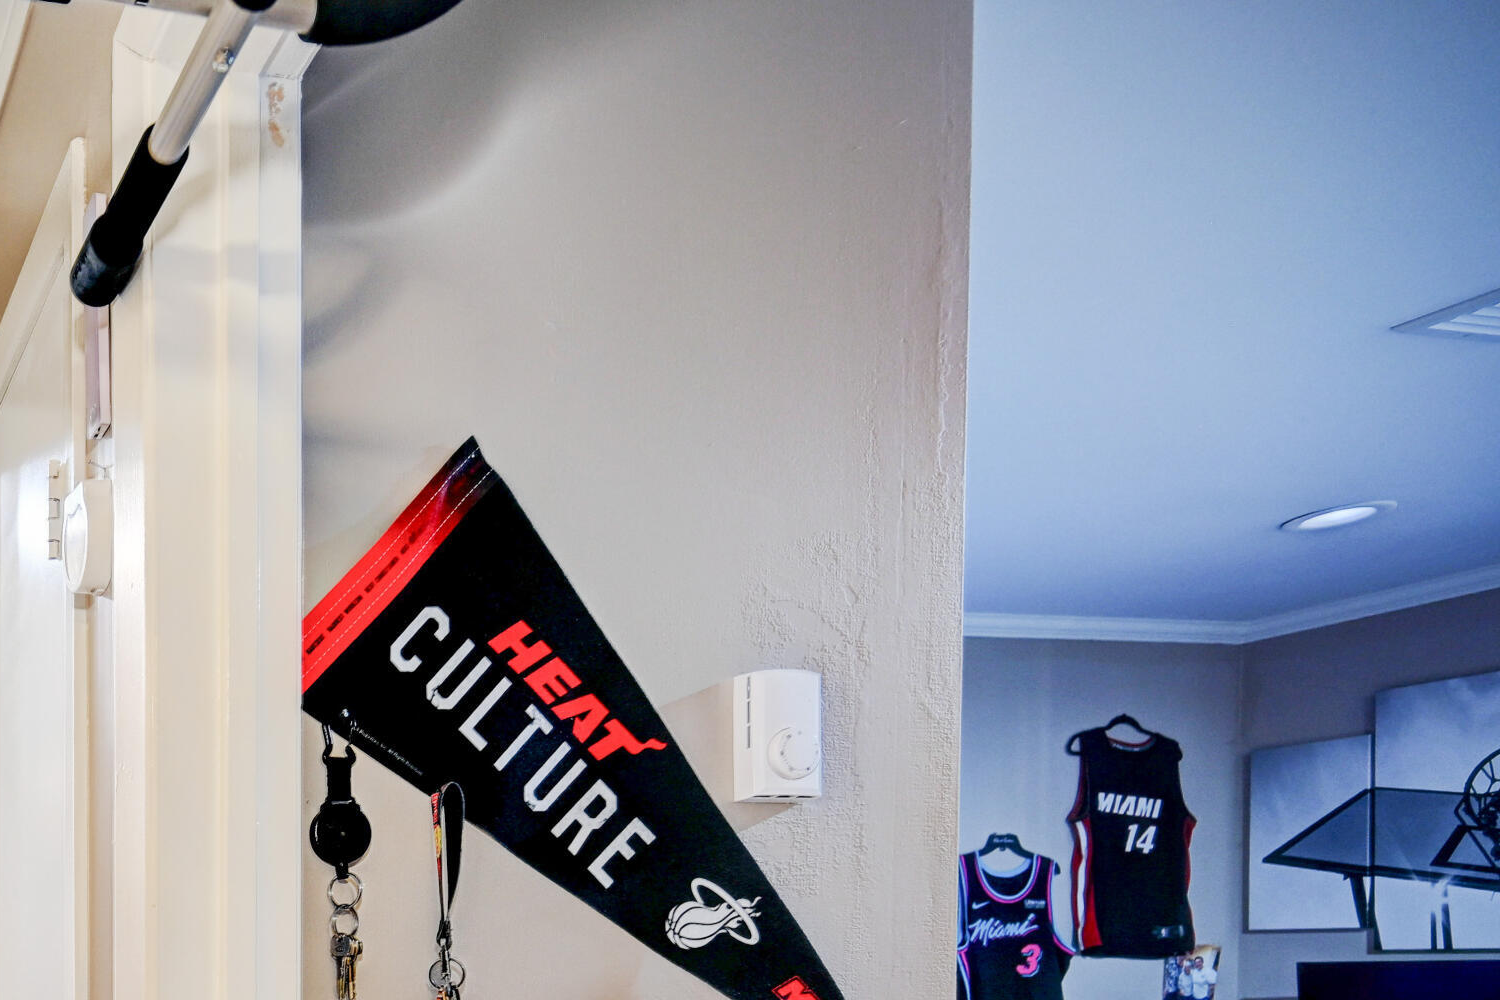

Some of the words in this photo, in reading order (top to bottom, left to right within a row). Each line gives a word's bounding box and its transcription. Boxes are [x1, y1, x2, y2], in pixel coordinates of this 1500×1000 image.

[487, 619, 667, 761] HEAT
[389, 606, 657, 890] CULTURE
[1097, 792, 1163, 819] MIAMI
[1125, 823, 1157, 854] 14
[969, 913, 1040, 946] Miami
[1016, 944, 1043, 977] 3
